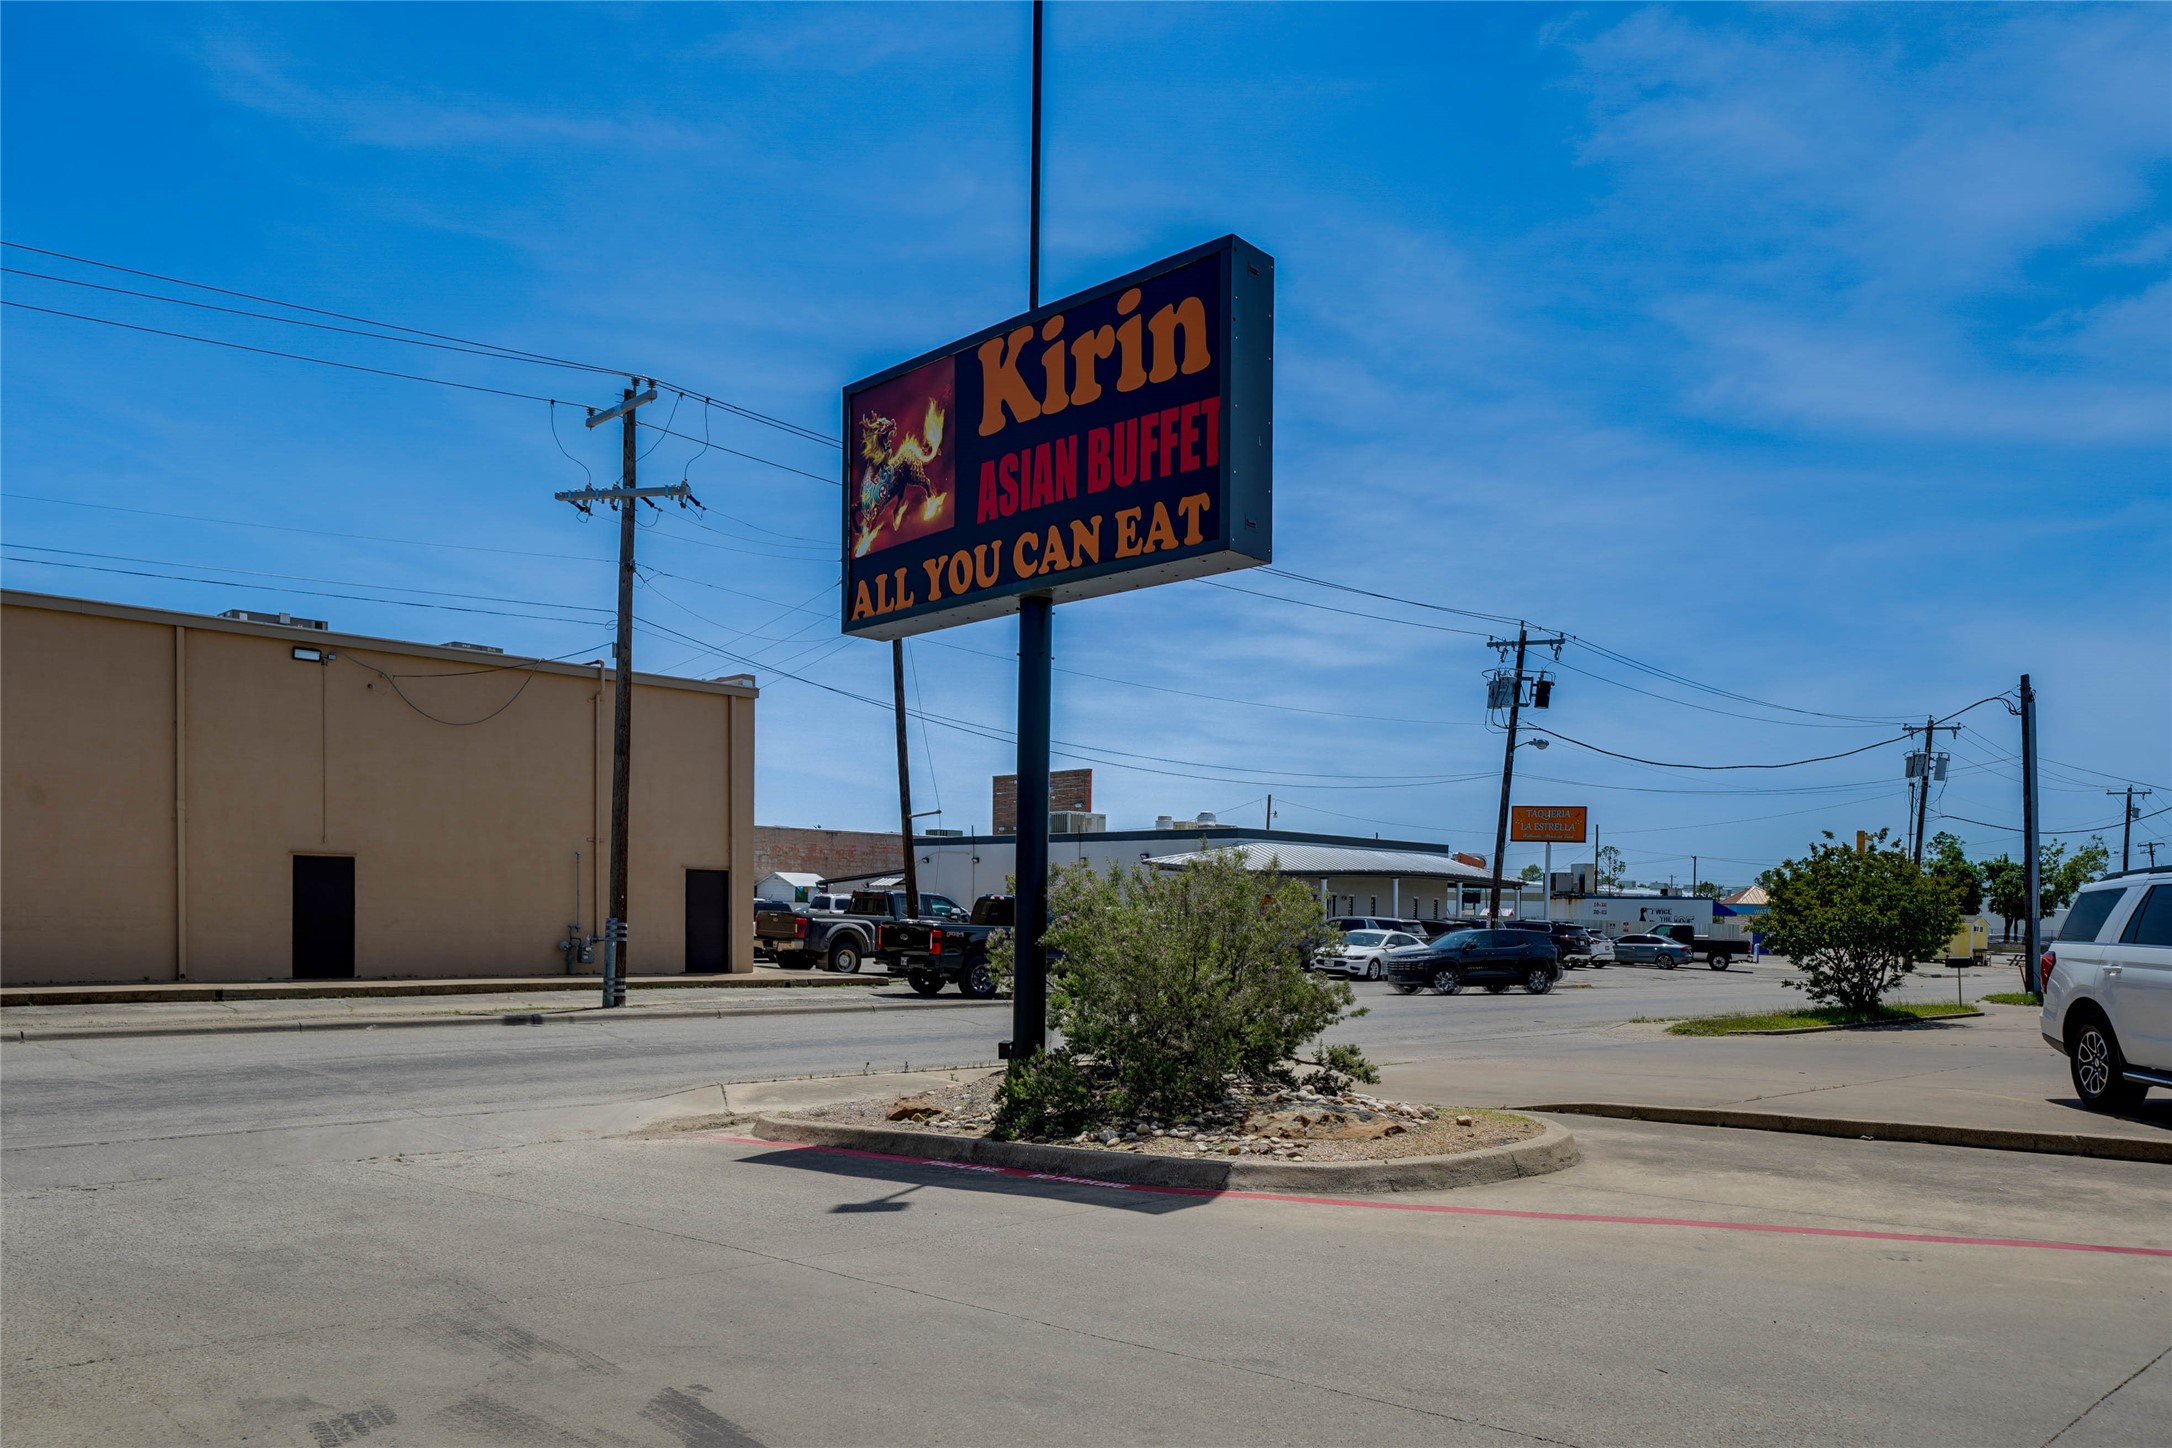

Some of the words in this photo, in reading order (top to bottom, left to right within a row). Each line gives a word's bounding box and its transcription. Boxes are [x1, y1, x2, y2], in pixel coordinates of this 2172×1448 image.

[977, 287, 1211, 436] Kirin
[976, 434, 1078, 524] ASIAN
[1087, 396, 1220, 494] BUFFET
[851, 567, 914, 621] ALL
[923, 539, 1002, 601] YOU
[1012, 515, 1103, 579] CAN
[1114, 492, 1210, 559] EAT
[1520, 823, 1533, 831] LA
[1534, 822, 1576, 832] ESTRELLA
[1526, 809, 1571, 820] TAQUERIA
